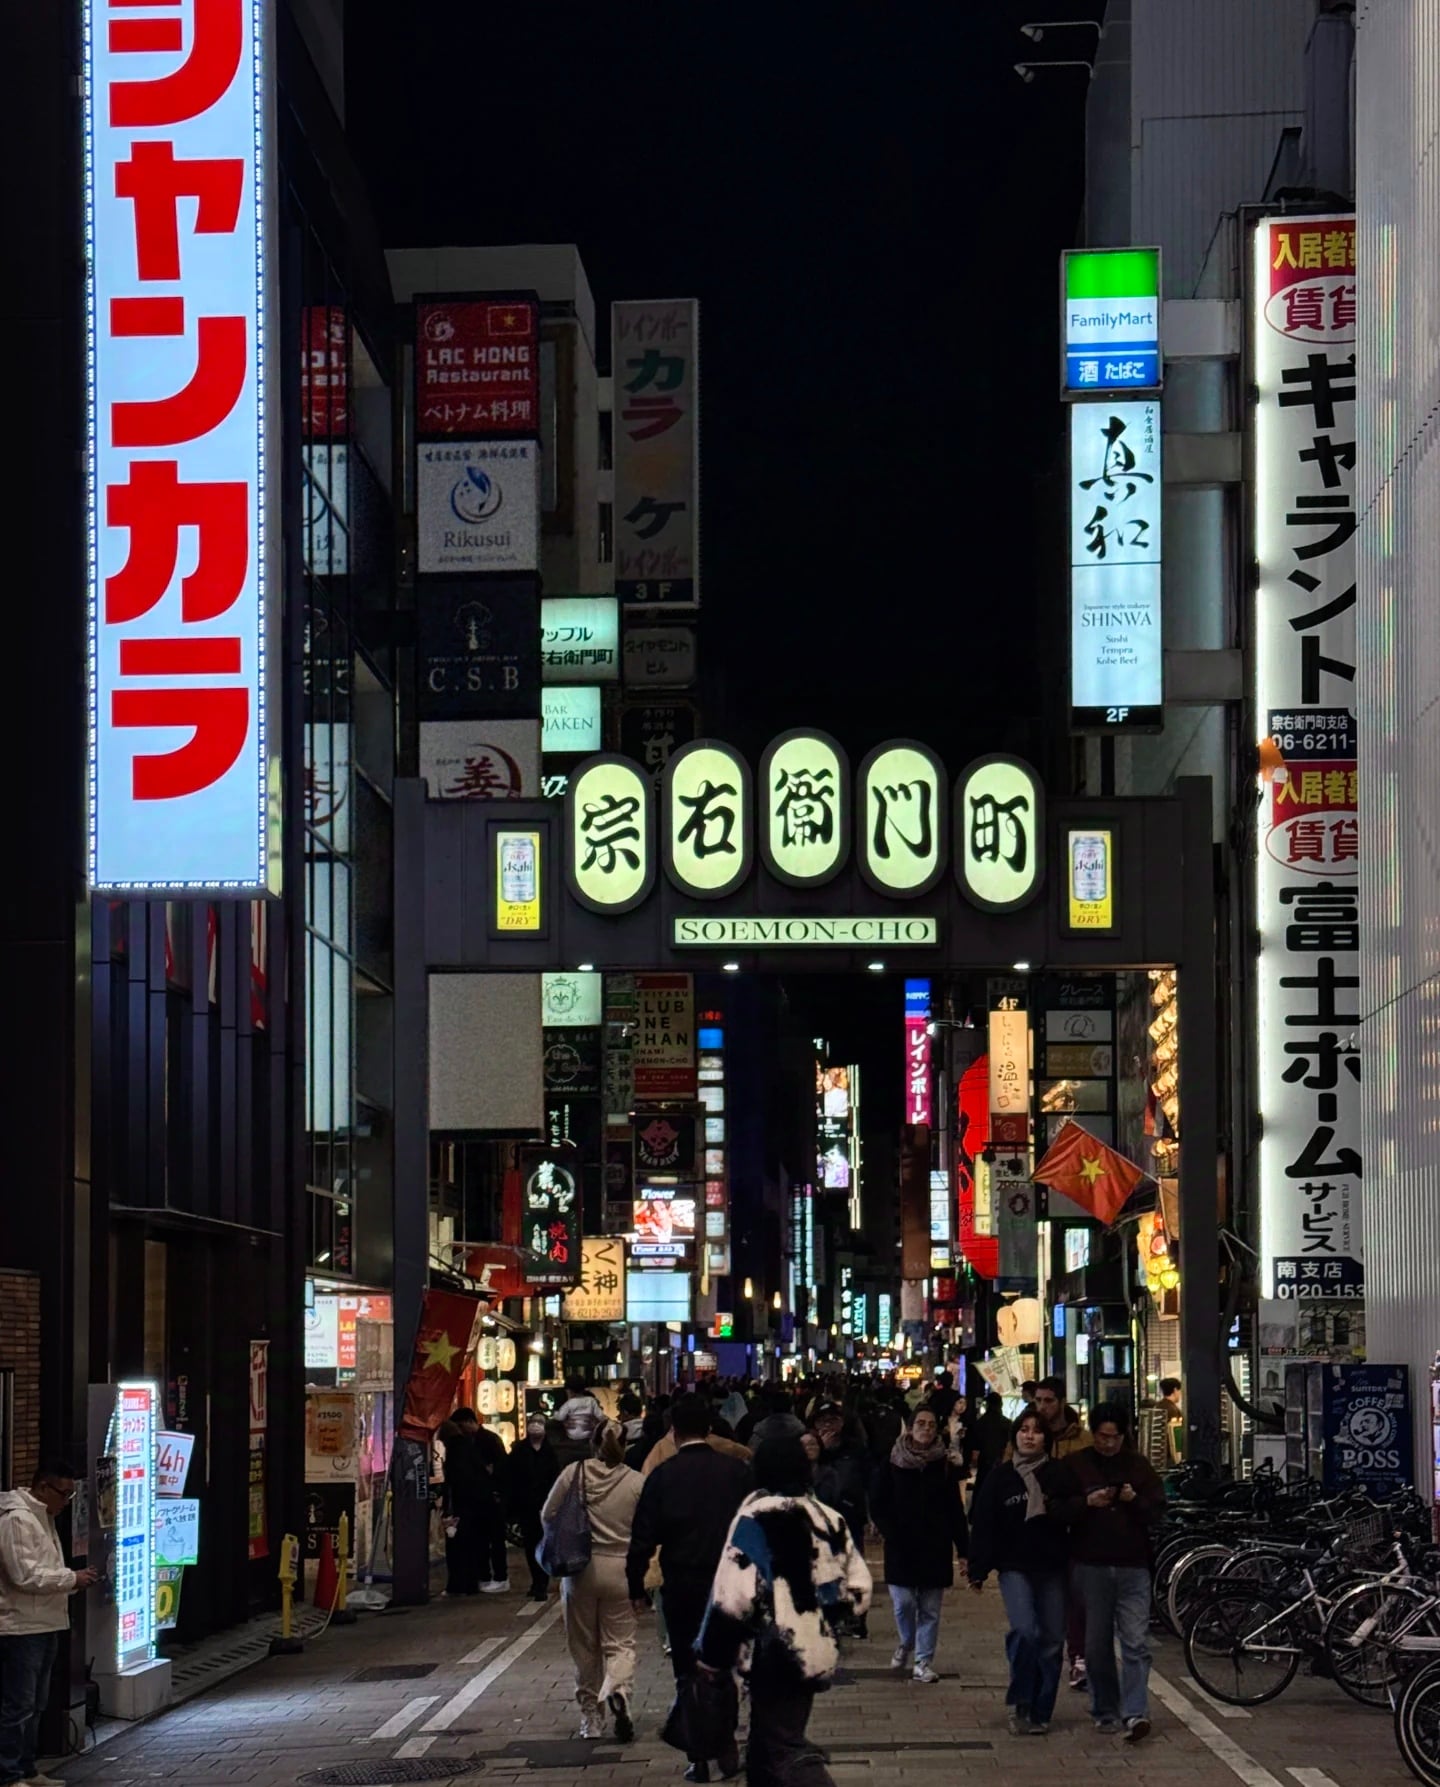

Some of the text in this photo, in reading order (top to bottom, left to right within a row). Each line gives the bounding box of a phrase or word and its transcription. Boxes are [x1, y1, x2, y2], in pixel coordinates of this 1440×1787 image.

[1273, 232, 1356, 270] 入居者
[1071, 312, 1152, 329] FamilyMart
[427, 345, 530, 366] LAC HONG
[427, 367, 531, 384] Restaurant
[1079, 361, 1145, 382] 酒 たばこ
[425, 401, 531, 422] ベトナム料理
[444, 531, 511, 549] Rikusui
[1081, 612, 1152, 627] SHINWA
[1105, 635, 1128, 643] Sushi
[545, 705, 567, 714] BAR
[1106, 708, 1129, 723] 2F
[541, 717, 593, 732] JAKEN
[1272, 715, 1348, 731] 宗右衛門町支店
[1276, 770, 1357, 804] 入居者
[581, 768, 1029, 874] 宗右衛門町
[503, 861, 532, 873] Asahi
[1075, 860, 1104, 871] Asahi
[680, 919, 930, 941] SOEMON-CHO
[998, 996, 1019, 1010] 4F
[1277, 1261, 1342, 1279] 南支店
[1342, 1450, 1400, 1469] BOSS
